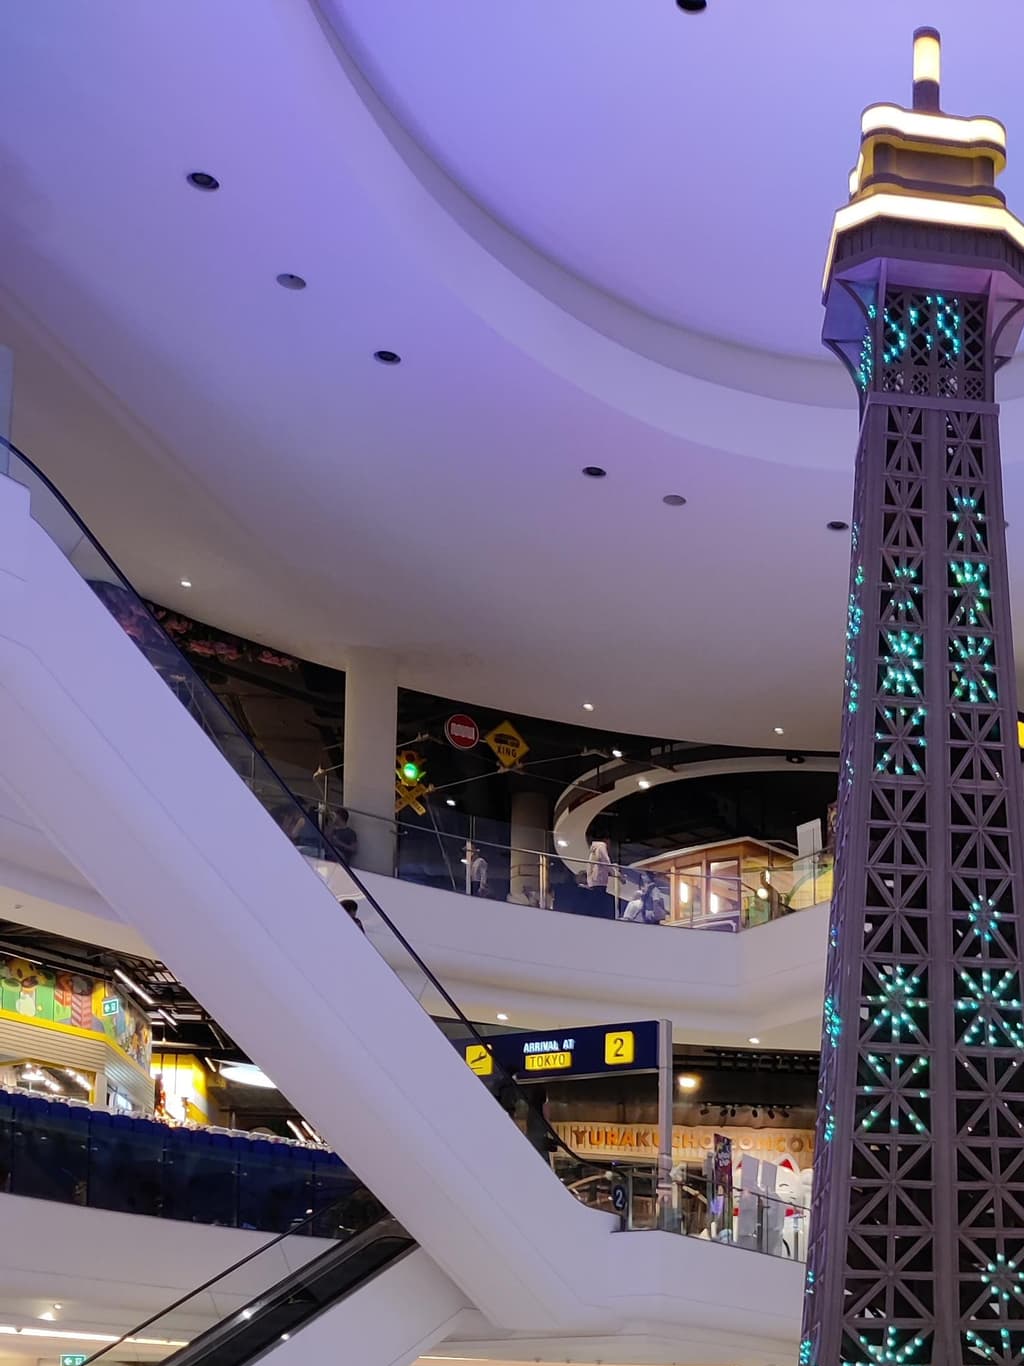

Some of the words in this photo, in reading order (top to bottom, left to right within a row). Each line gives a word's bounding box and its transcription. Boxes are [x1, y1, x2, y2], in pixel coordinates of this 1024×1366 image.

[497, 745, 517, 758] XING
[523, 1040, 560, 1054] ARRIVAL
[562, 1038, 575, 1050] AT
[612, 1038, 625, 1057] 2
[530, 1053, 566, 1067] TOKYO
[614, 1190, 624, 1208] 2
